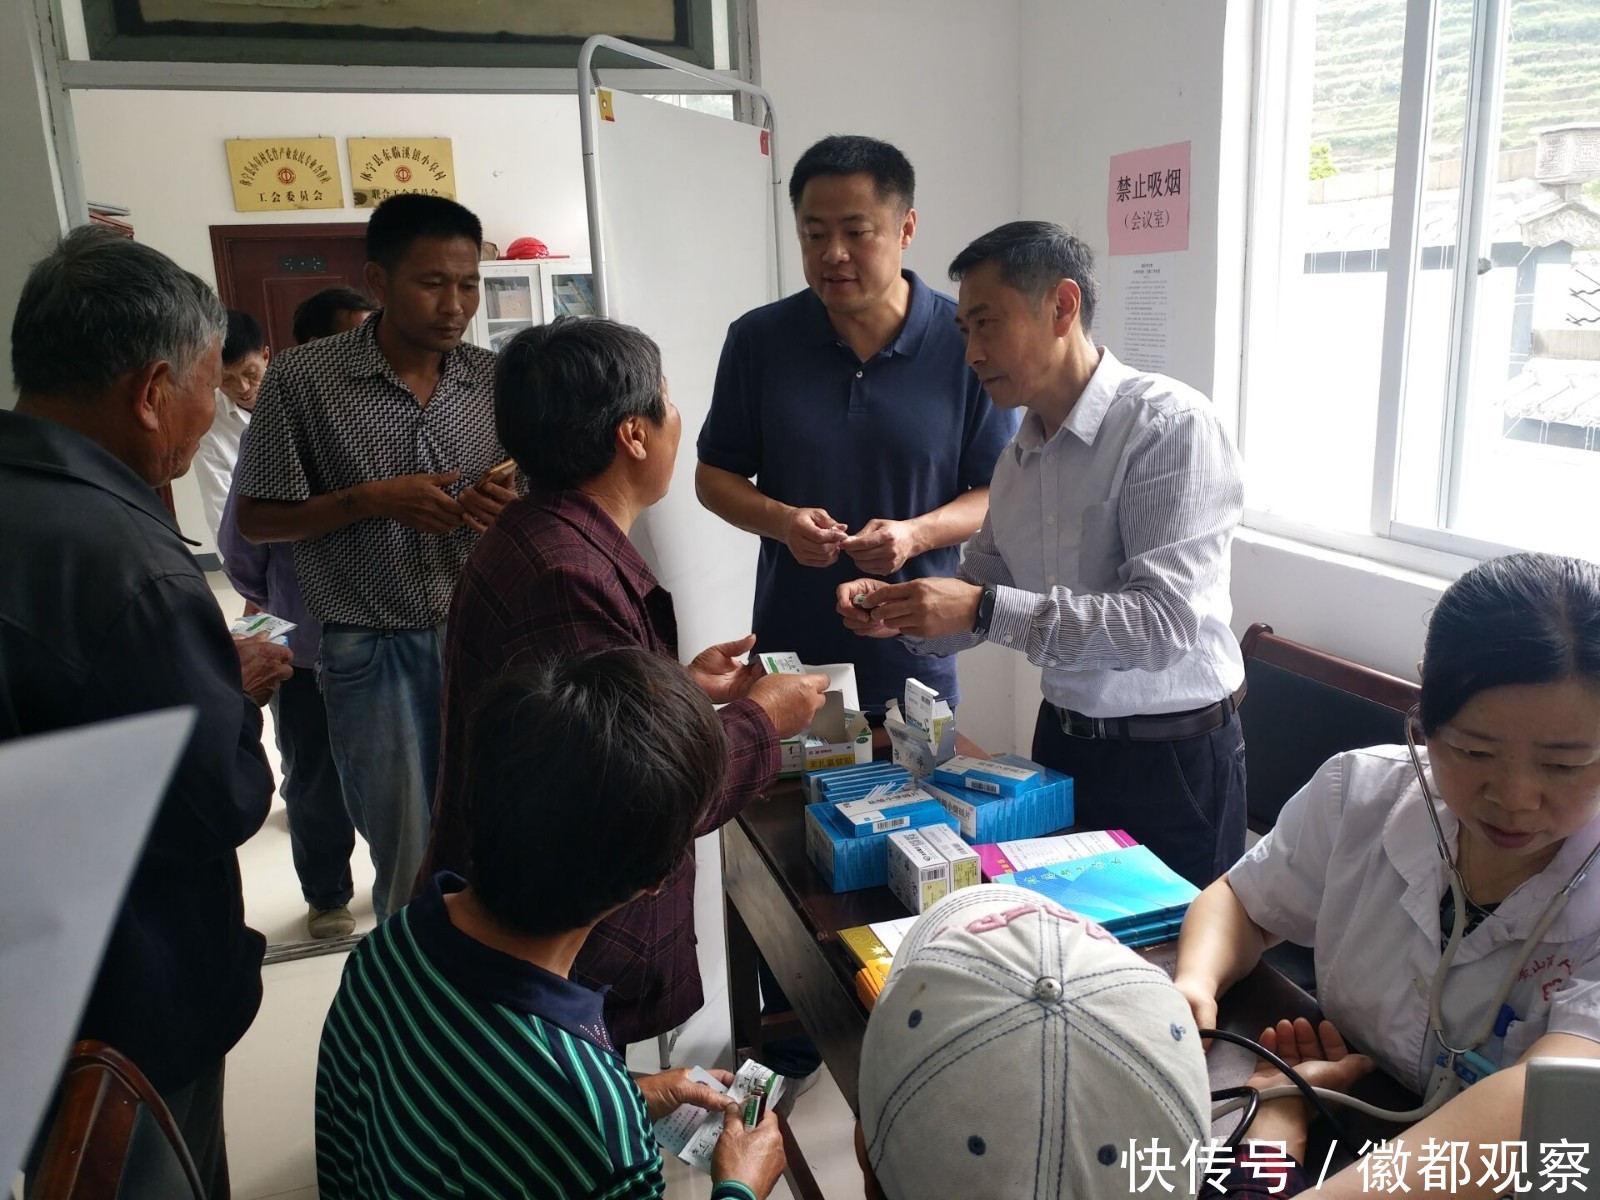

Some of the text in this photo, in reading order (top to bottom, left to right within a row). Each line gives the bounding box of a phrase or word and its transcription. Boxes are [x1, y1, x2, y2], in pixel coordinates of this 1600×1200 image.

[258, 189, 323, 203] 工会委员会
[1116, 168, 1181, 203] 禁止吸烟
[1124, 209, 1170, 231] （会议室）
